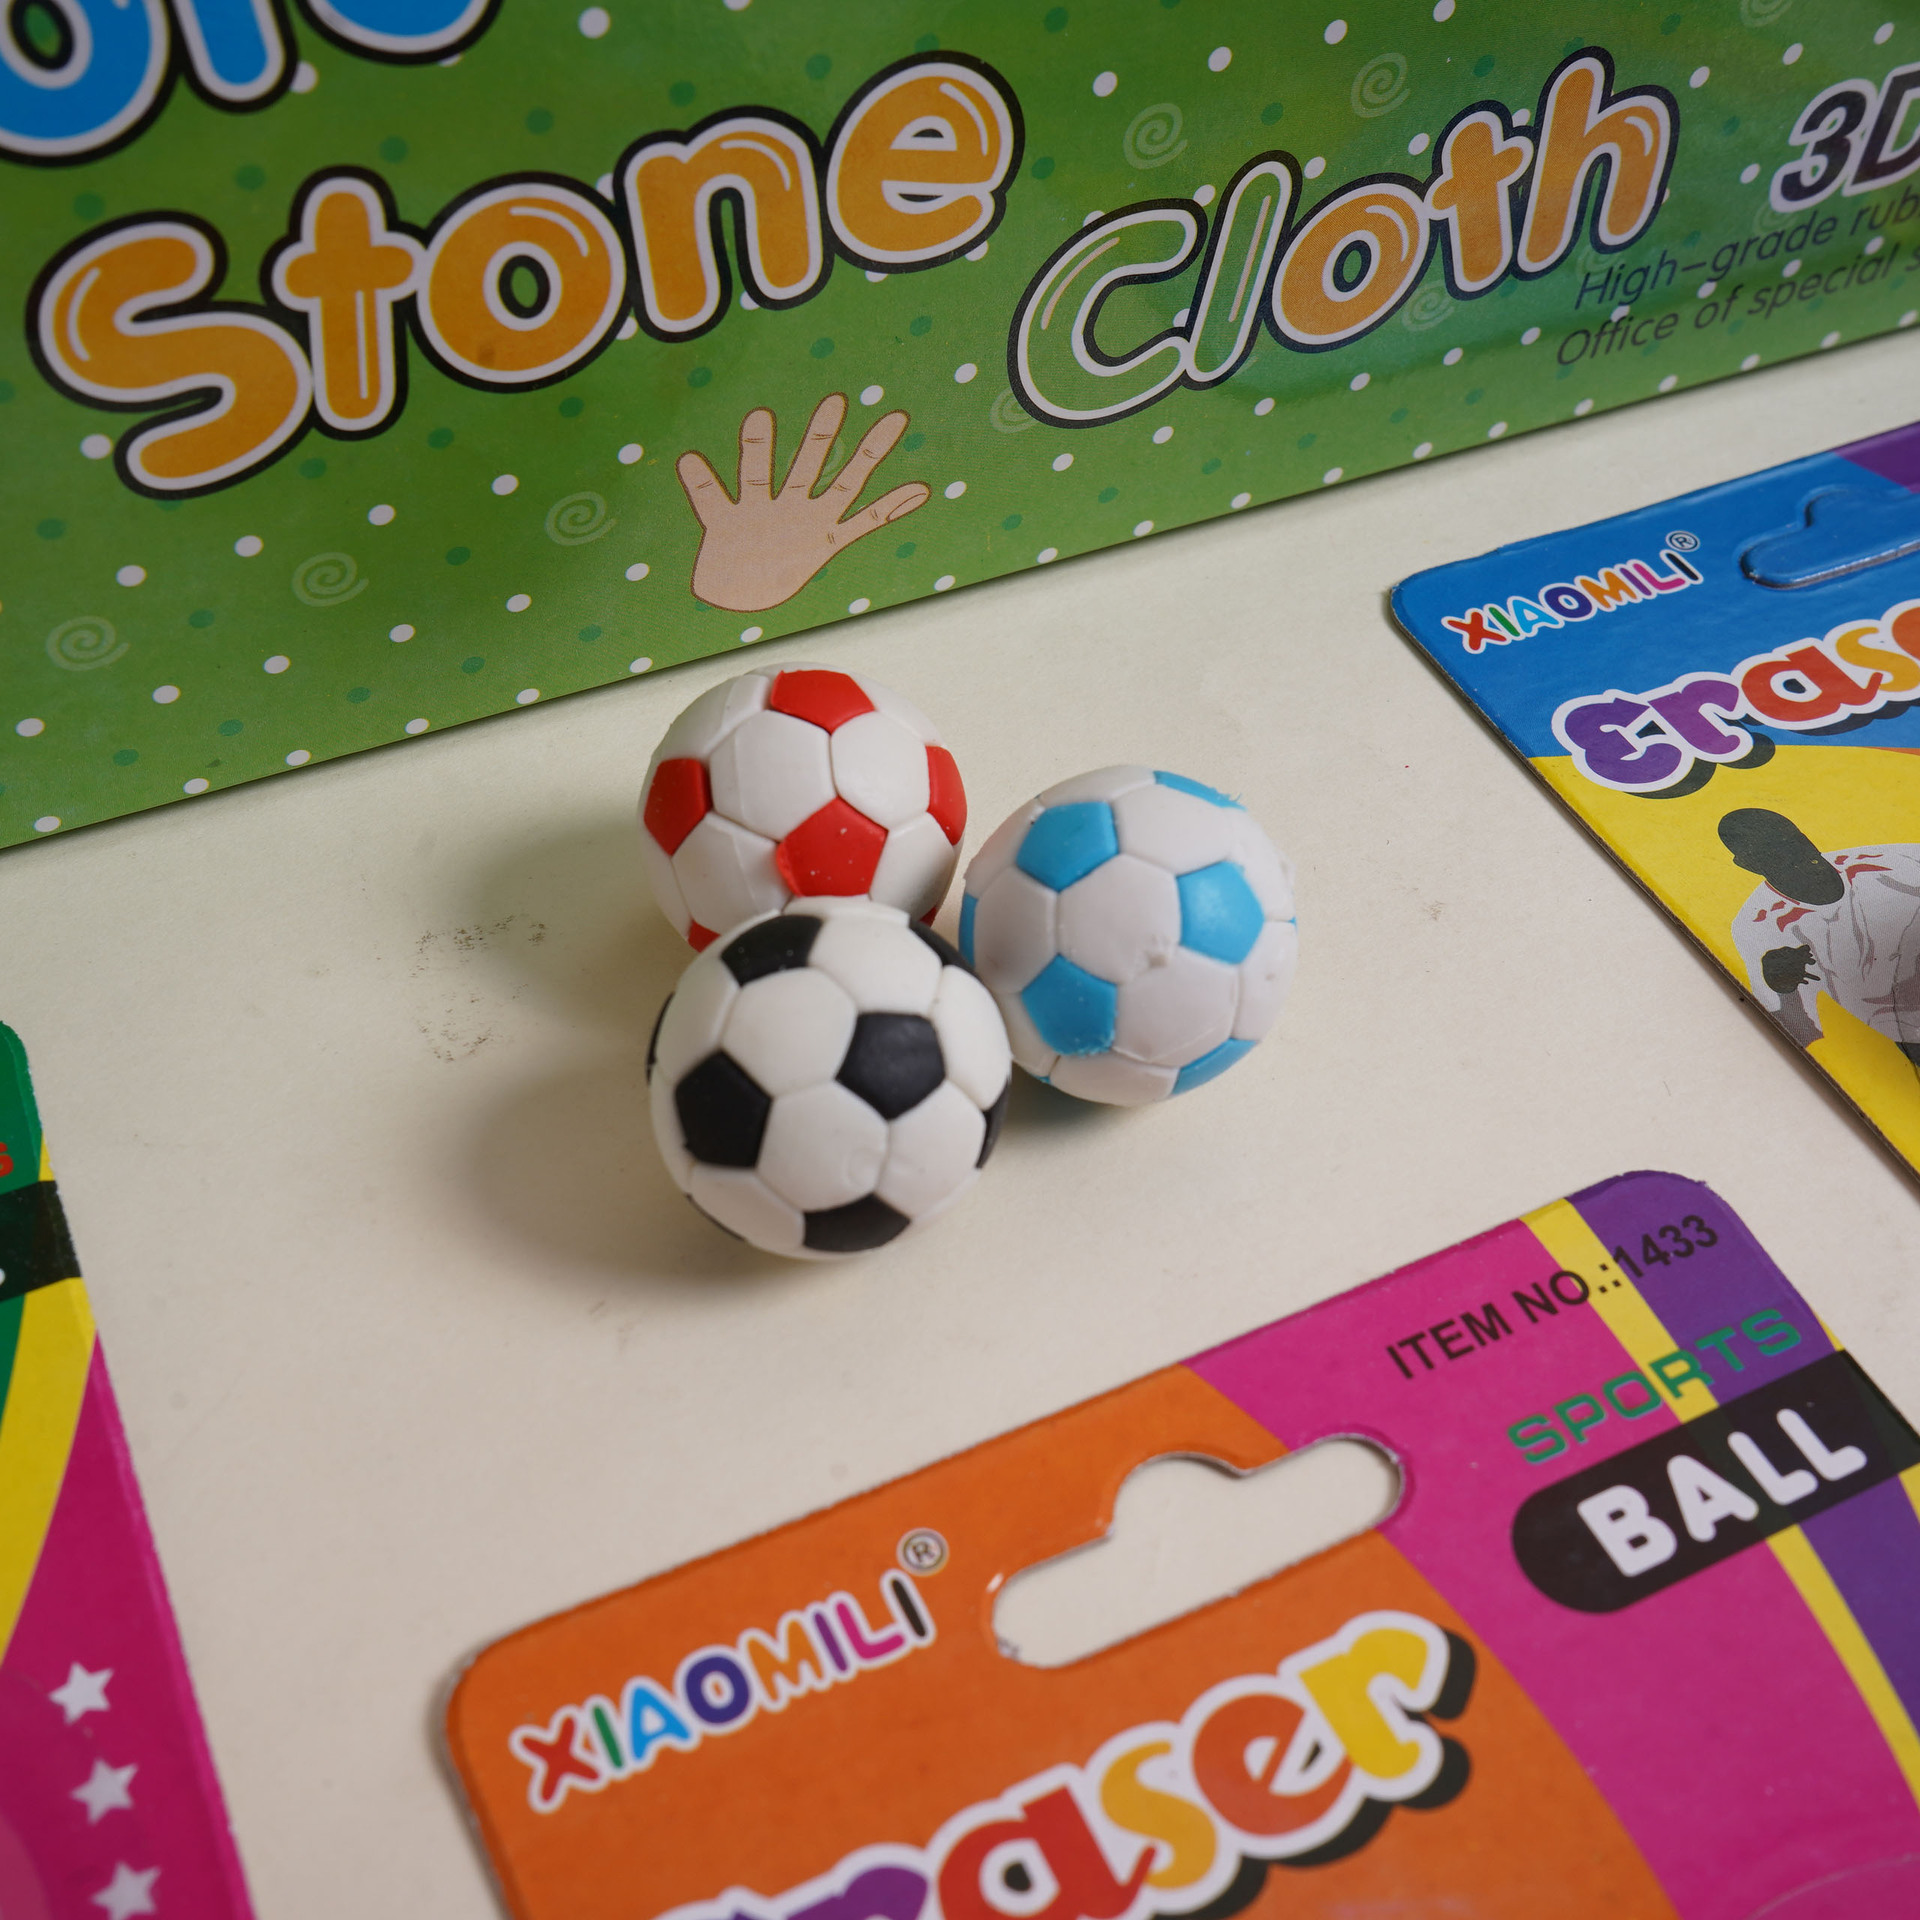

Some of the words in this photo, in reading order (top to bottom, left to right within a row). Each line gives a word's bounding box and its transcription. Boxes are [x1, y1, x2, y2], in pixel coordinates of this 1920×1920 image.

[27, 51, 1025, 499] Stone
[1557, 313, 1679, 365] Office
[1694, 285, 1744, 329] of
[1747, 241, 1901, 319] special
[1574, 211, 1837, 309] High-grade
[1849, 186, 1920, 237] rub
[1443, 549, 1703, 653] XIAOMILI
[1386, 1301, 1514, 1380] ITEM
[1508, 1308, 1802, 1465] SPORTS
[1576, 1408, 1868, 1577] BALL
[508, 1568, 936, 1814] XIAOMILI
[650, 1610, 1477, 1920] aser
